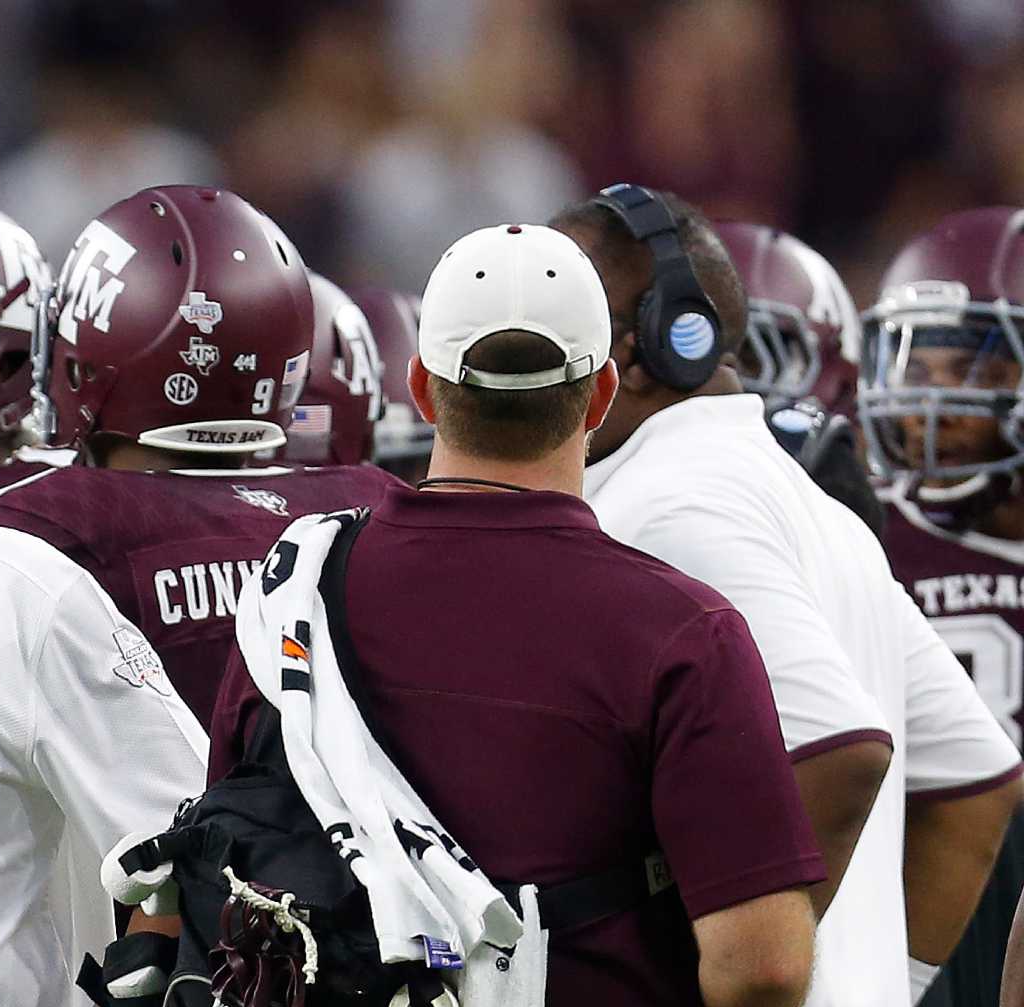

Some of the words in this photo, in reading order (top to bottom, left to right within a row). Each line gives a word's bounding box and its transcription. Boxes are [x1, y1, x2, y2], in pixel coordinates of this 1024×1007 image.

[166, 375, 197, 403] SEC
[251, 377, 275, 415] 9
[185, 429, 237, 444] TEXAS
[914, 573, 1024, 616] TEXA
